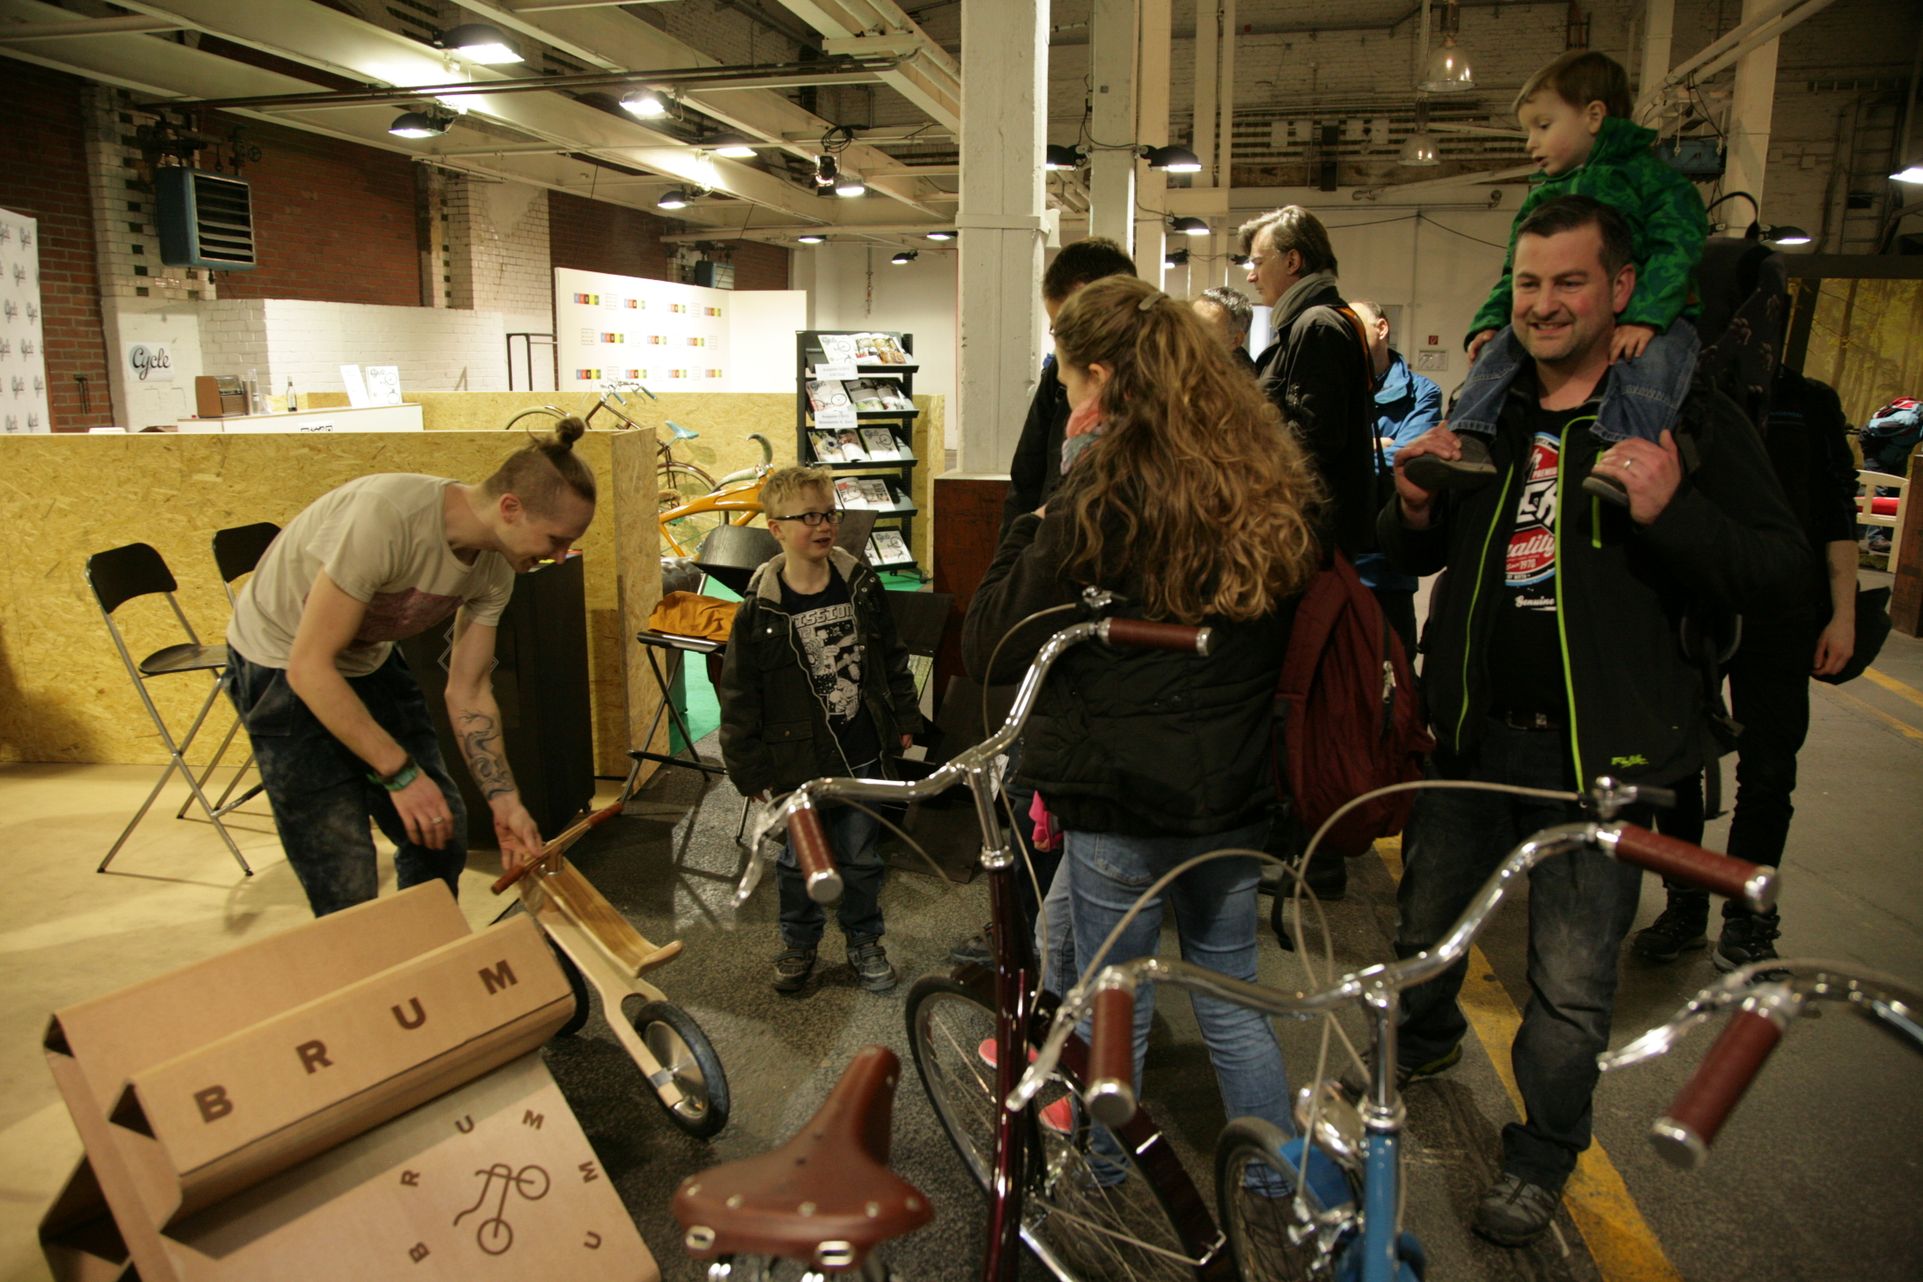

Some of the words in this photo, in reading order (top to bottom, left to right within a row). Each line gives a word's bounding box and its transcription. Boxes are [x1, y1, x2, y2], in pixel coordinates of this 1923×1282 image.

[132, 347, 170, 381] Cycle
[1506, 534, 1554, 558] uality
[793, 602, 854, 628] ISSION
[193, 960, 518, 1124] BRUM
